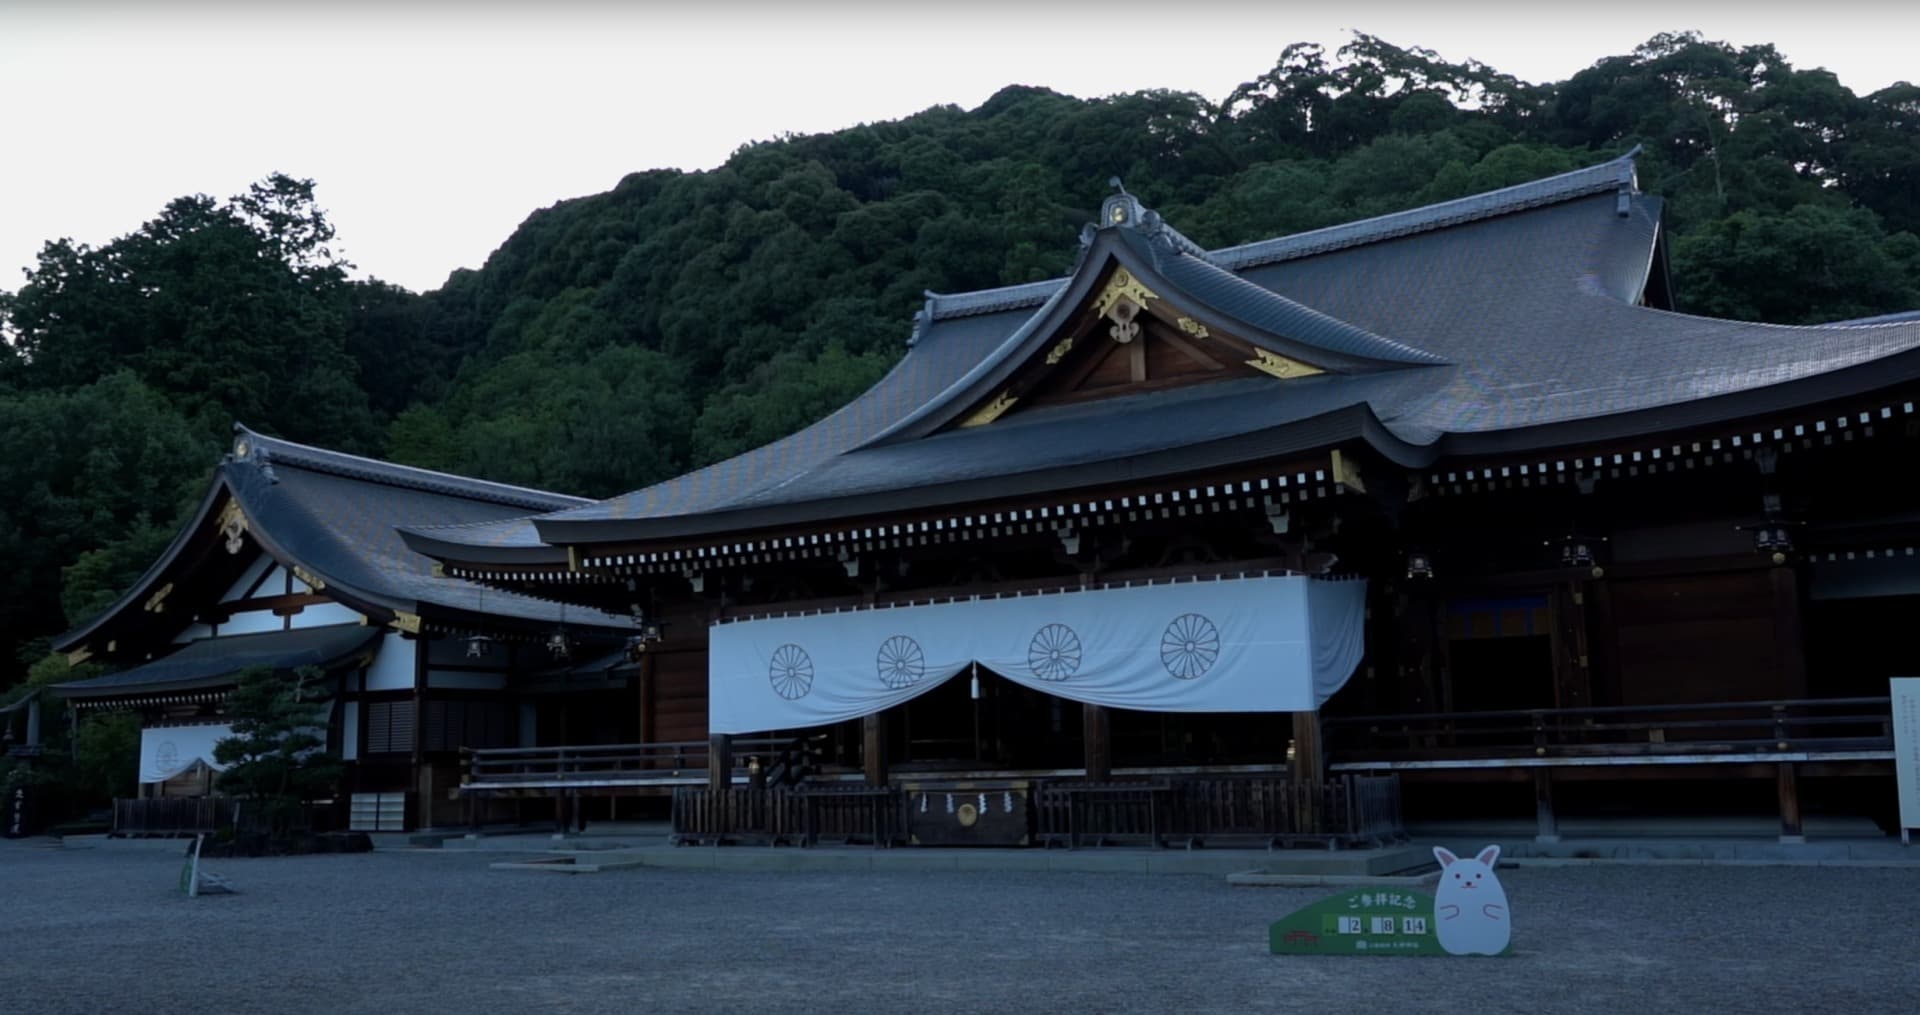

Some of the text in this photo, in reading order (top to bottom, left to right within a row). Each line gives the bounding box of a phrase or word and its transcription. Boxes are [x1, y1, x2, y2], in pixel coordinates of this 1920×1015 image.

[1352, 920, 1360, 931] 2
[1384, 920, 1393, 931] 8
[1405, 920, 1424, 931] 14
